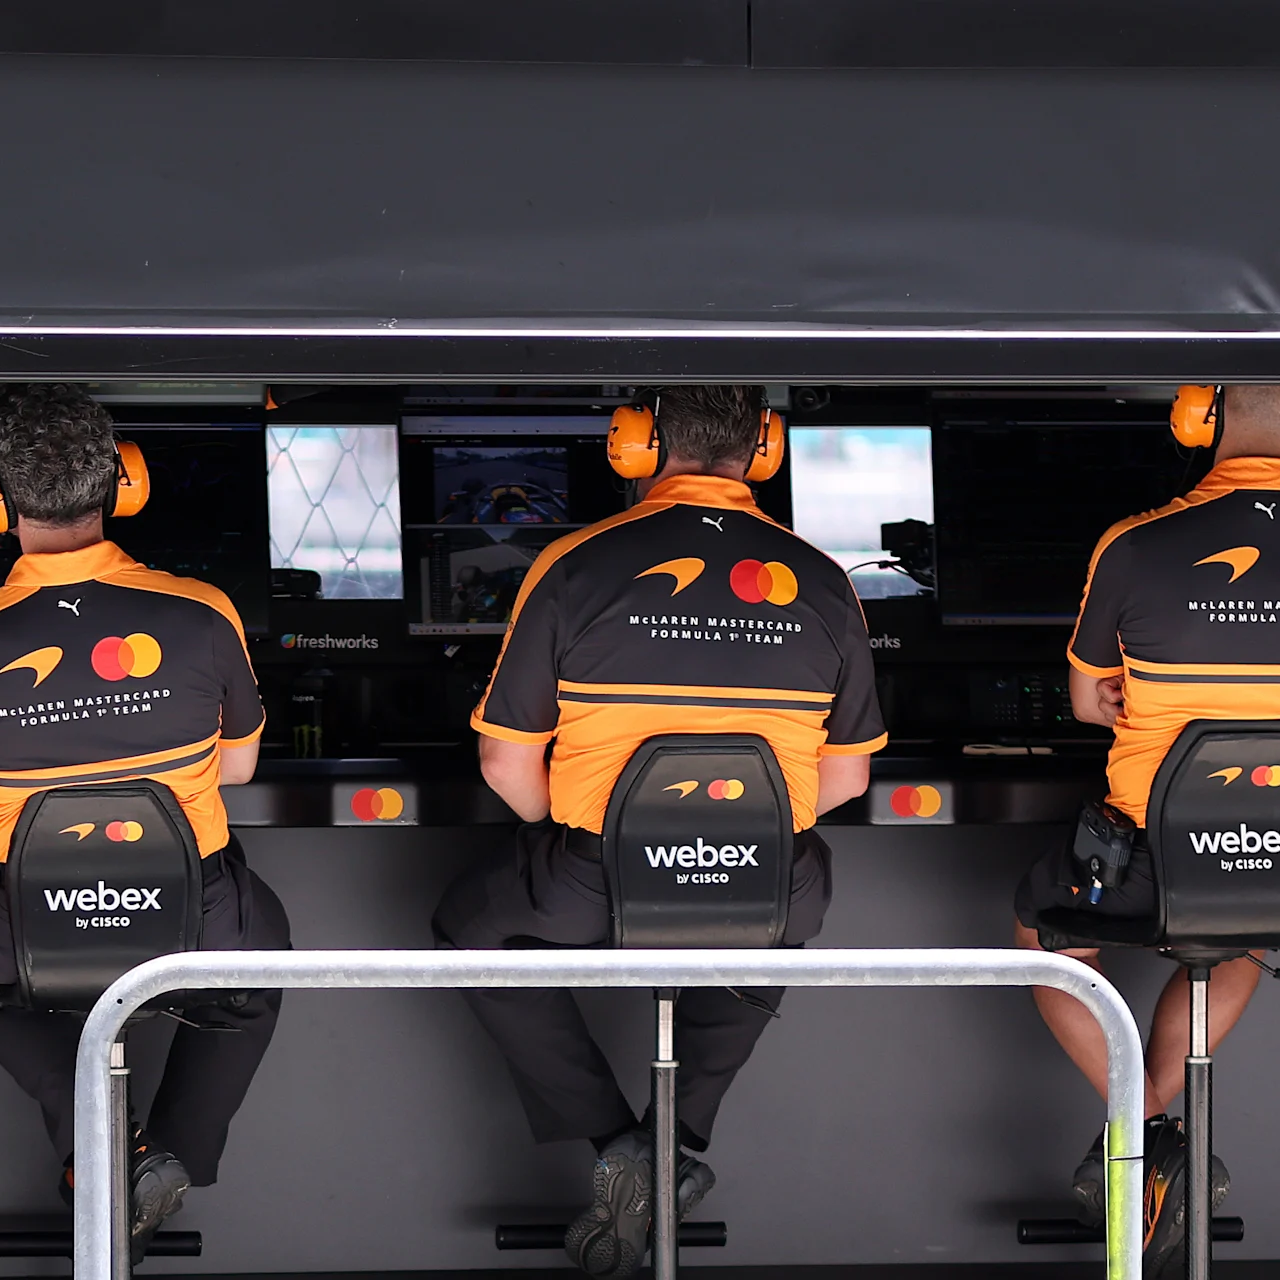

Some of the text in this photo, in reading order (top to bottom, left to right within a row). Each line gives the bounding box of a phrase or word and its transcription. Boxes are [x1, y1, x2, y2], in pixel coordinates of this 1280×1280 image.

[707, 617, 802, 633] MASTERCARD
[1209, 613, 1277, 623] FORMULA
[296, 633, 379, 649] freshworks
[650, 628, 722, 641] FORMULA
[745, 633, 783, 645] TEAM
[73, 688, 171, 708] MASTERCARD
[20, 709, 90, 727] FORMULA
[112, 702, 152, 716] TEAM
[644, 837, 759, 868] webex
[1220, 858, 1273, 873] by CISCO
[691, 872, 730, 884] CISCO
[43, 880, 162, 911] webex
[75, 916, 131, 930] by CISCO
